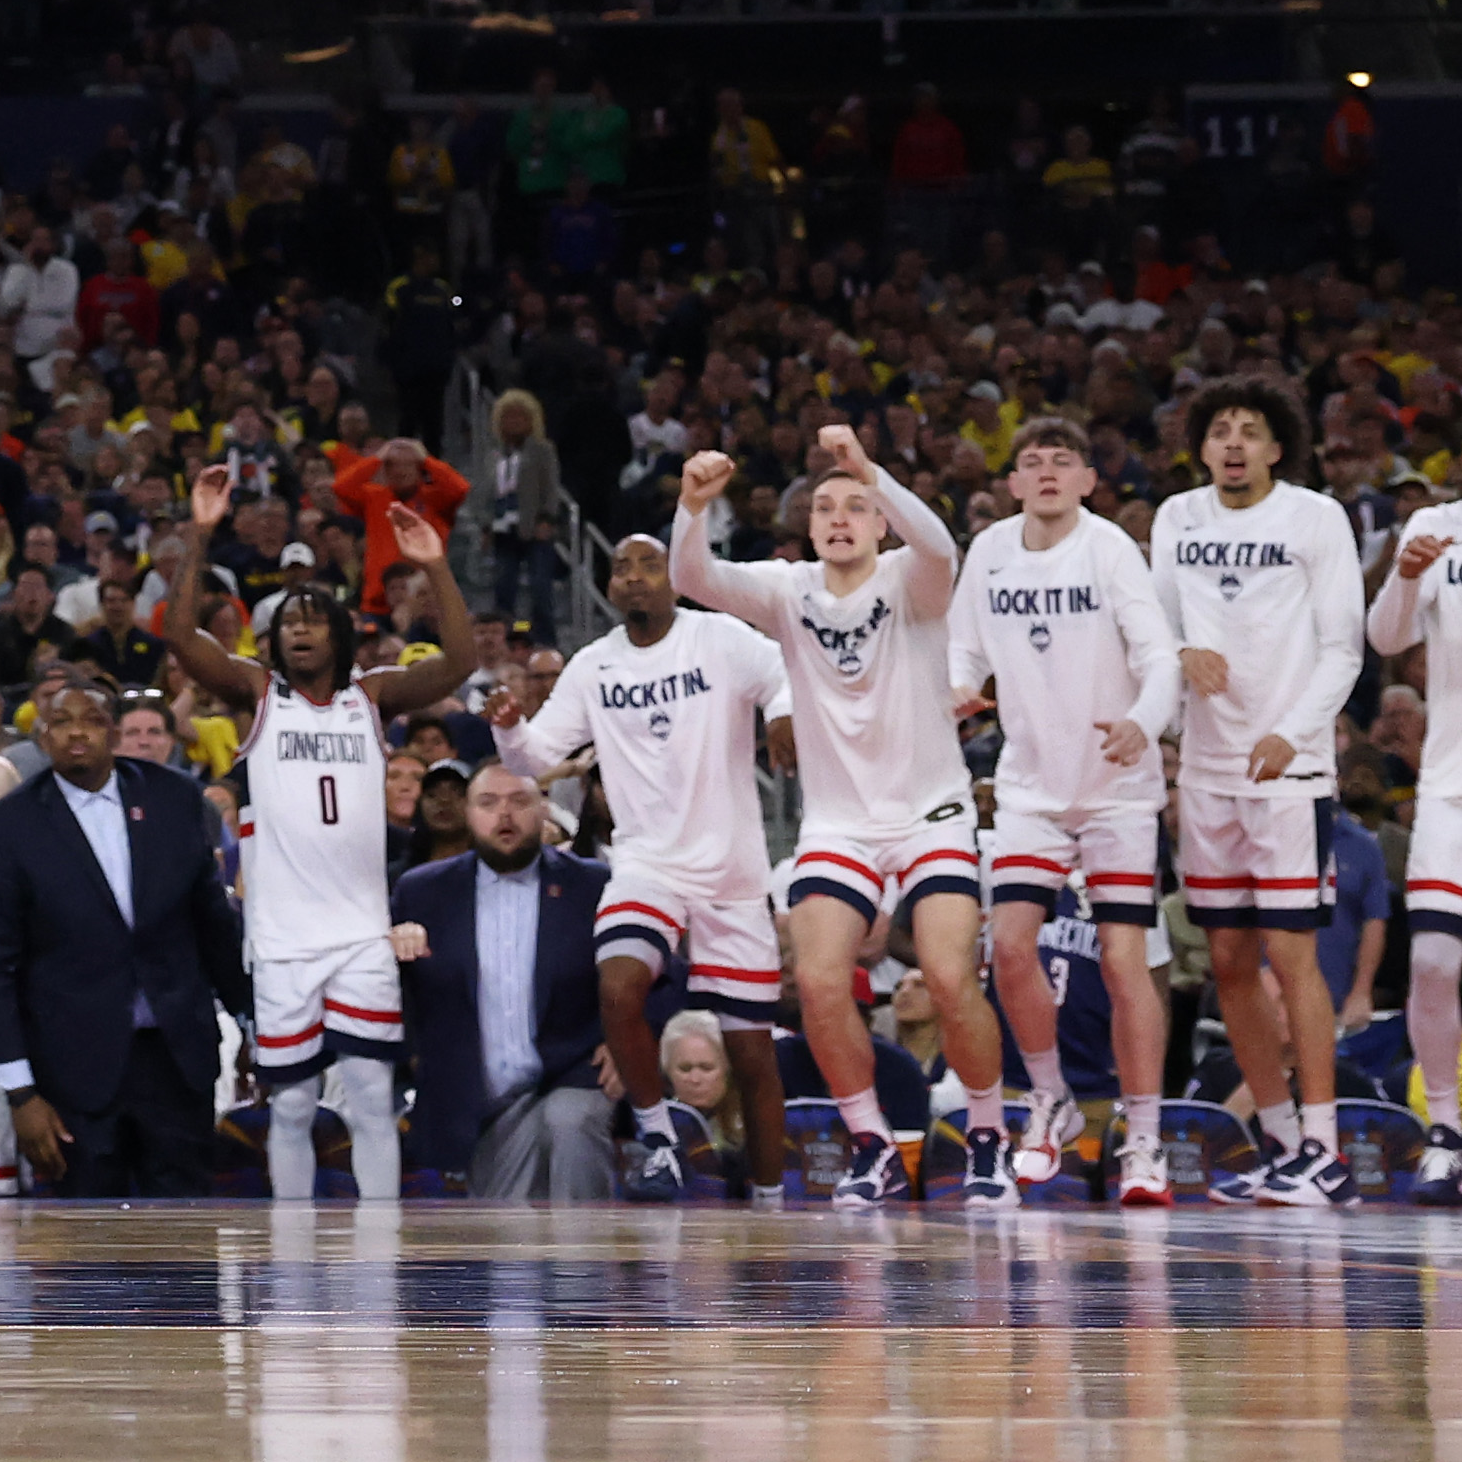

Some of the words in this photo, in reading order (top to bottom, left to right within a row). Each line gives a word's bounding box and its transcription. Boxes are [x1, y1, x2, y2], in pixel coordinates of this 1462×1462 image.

[1175, 541, 1231, 567] LOCK
[1235, 542, 1256, 567] IT
[988, 588, 1039, 615] LOCK
[1044, 588, 1063, 615] IT
[599, 682, 658, 710] LOCK
[660, 675, 678, 702] IT
[319, 775, 339, 825] 0
